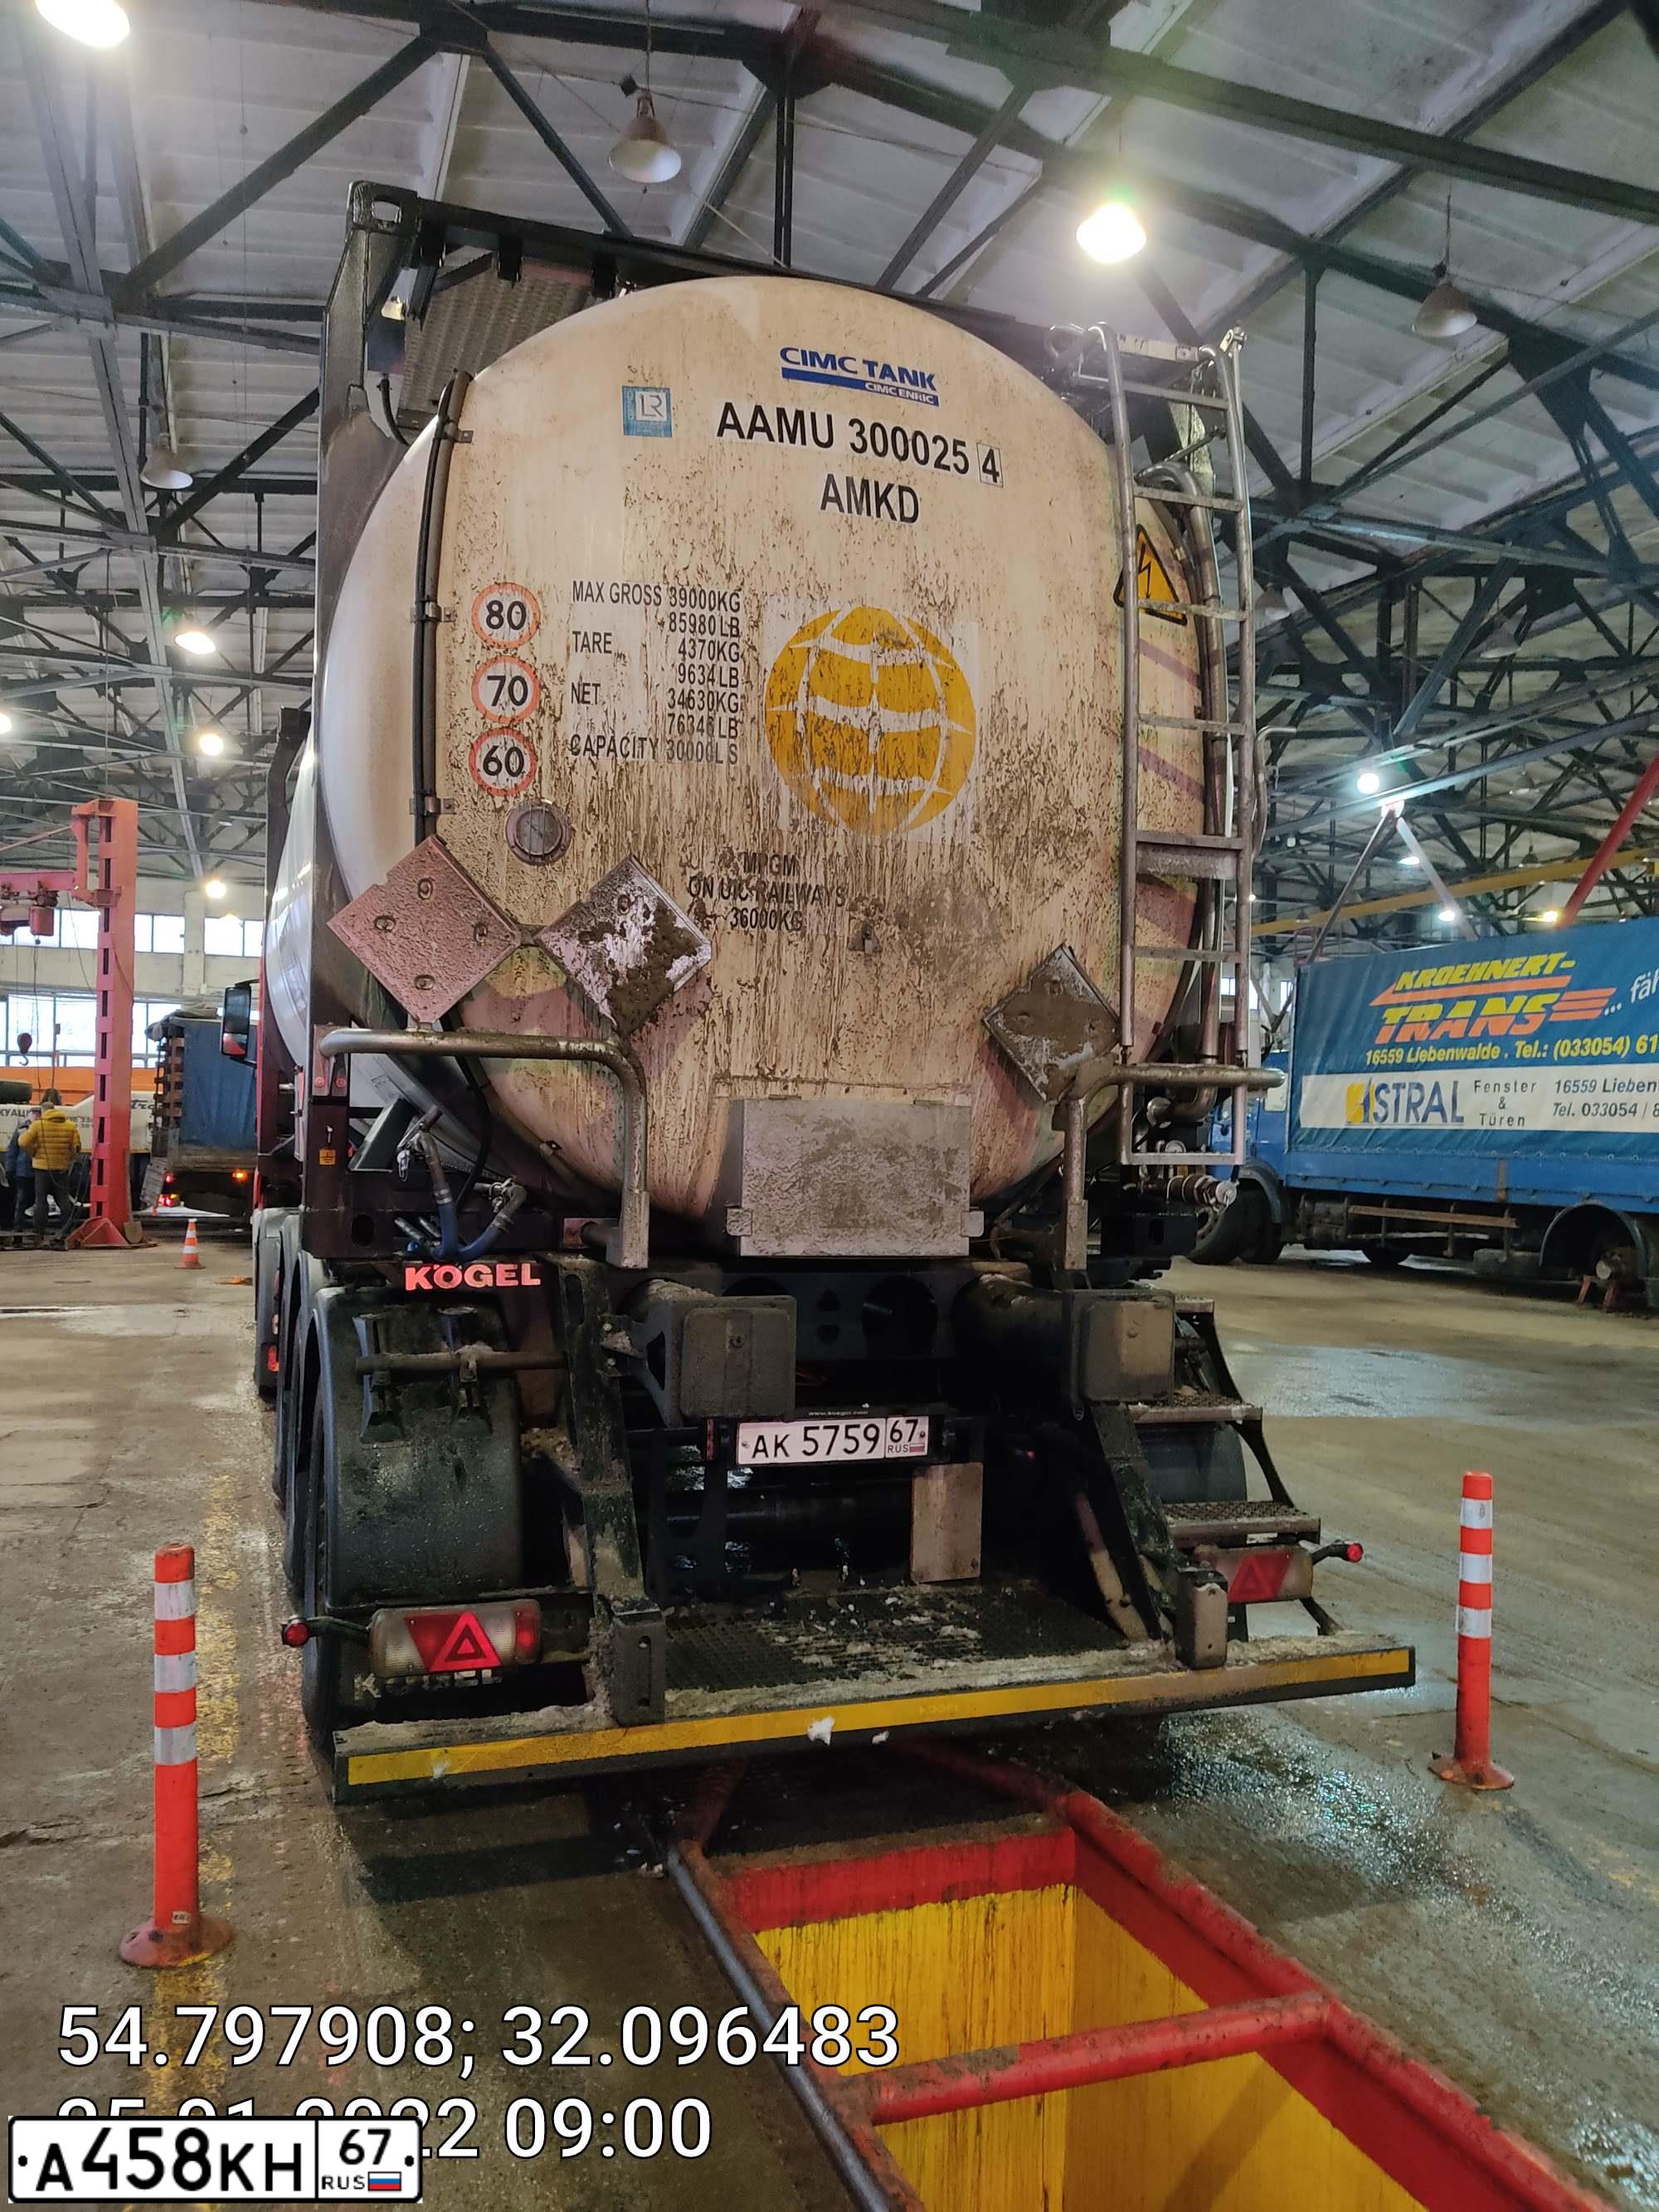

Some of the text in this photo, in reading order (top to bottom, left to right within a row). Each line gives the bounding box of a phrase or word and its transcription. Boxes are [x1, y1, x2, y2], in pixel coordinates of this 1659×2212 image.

[780, 347, 937, 392] CIMC TANK
[864, 382, 898, 396] CIMC
[717, 402, 1000, 483] AAMU 300025 4
[820, 474, 919, 524] AMKD
[572, 581, 605, 602] MAX
[610, 582, 662, 607] GROSS
[486, 600, 527, 631] 80
[572, 631, 612, 654] TARE
[487, 675, 528, 706] 70
[571, 682, 601, 705] NET
[483, 746, 524, 777] 60
[569, 734, 659, 760] CAPACITY
[689, 876, 713, 899] ON
[755, 879, 846, 908] RAILWAYS
[1374, 992, 1560, 1045] TRANS
[1366, 1049, 1404, 1065] 16559
[1407, 1043, 1501, 1064] Liebenwalde
[1515, 1040, 1548, 1060] Tel.:
[1553, 1035, 1632, 1060] (033054)
[1474, 1077, 1659, 1095] Fenster 16559 Lieben
[1480, 1113, 1525, 1128] Türen
[1553, 1102, 1575, 1118] Tel.
[1581, 1101, 1638, 1118] 033054
[1498, 1097, 1507, 1110] &
[800, 1423, 880, 1457] 5759
[889, 1419, 919, 1443] 67
[887, 1444, 909, 1454] RUS
